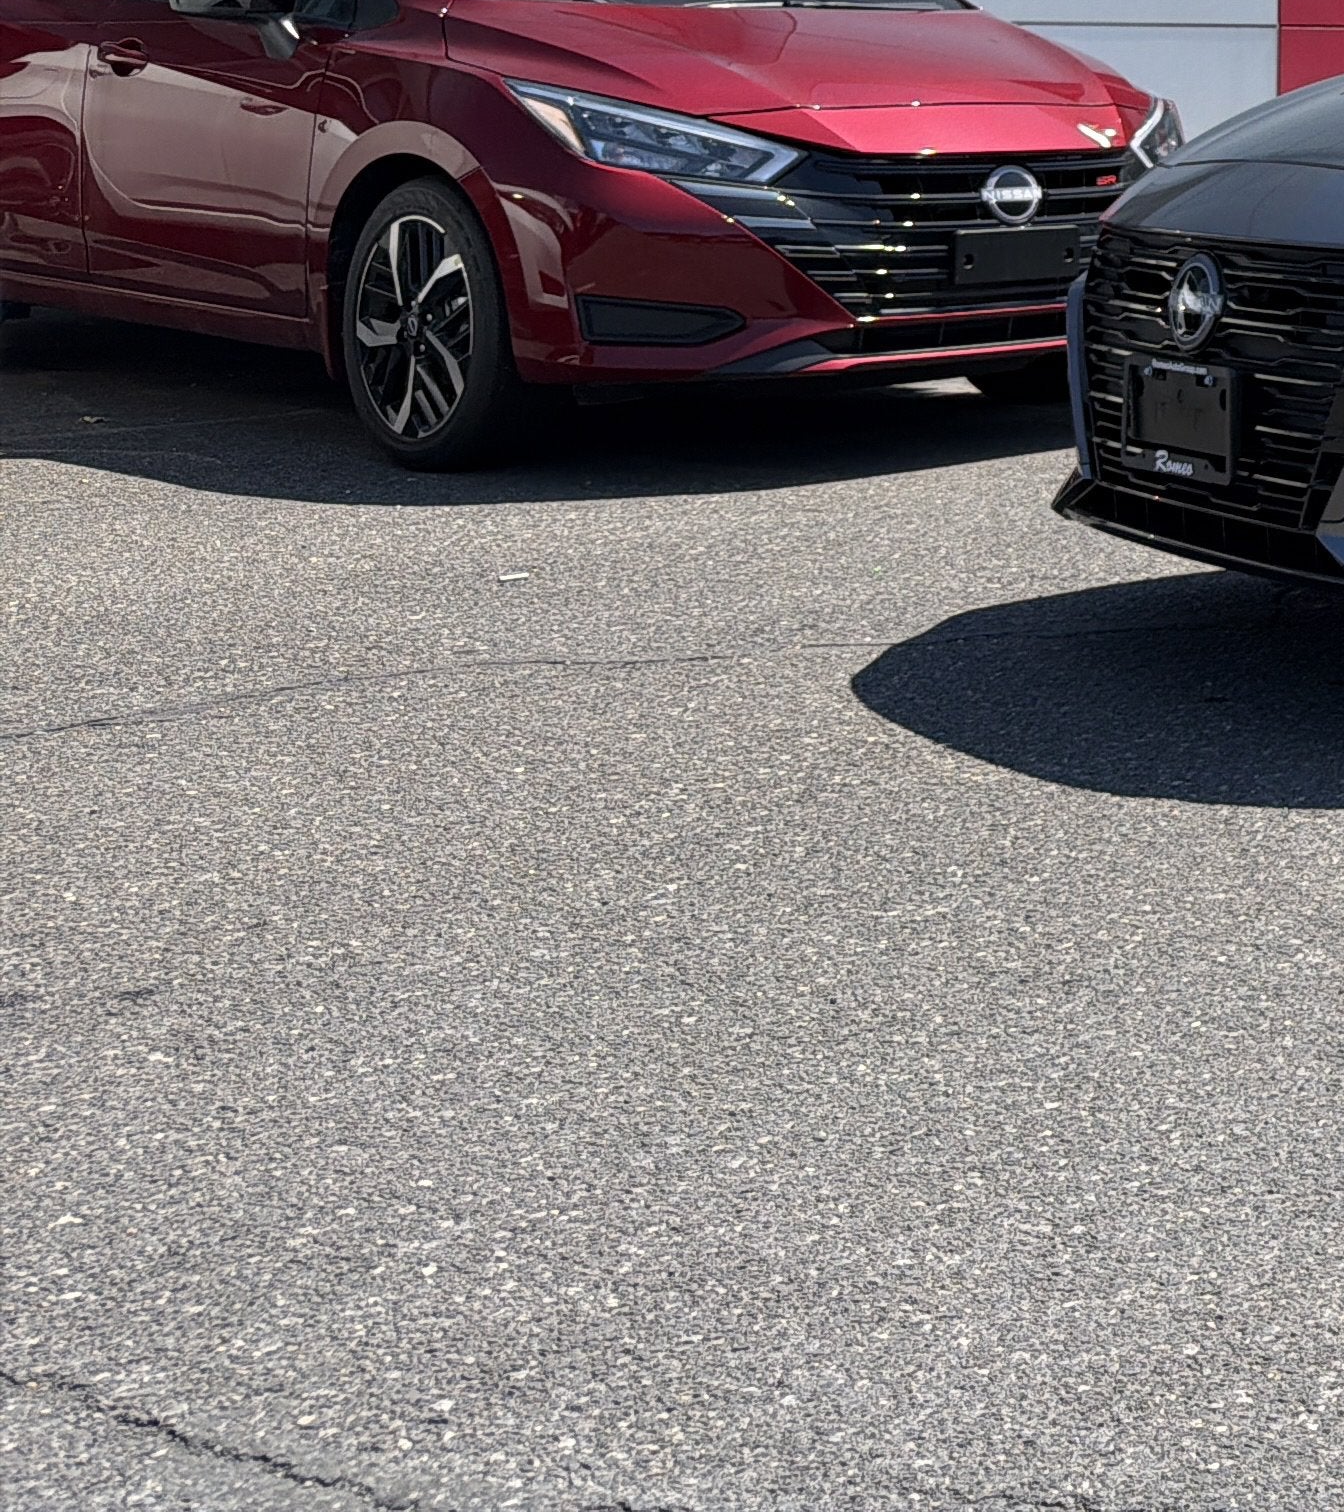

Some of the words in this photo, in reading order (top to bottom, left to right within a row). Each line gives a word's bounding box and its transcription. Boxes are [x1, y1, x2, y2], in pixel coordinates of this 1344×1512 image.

[1096, 174, 1117, 186] SR
[983, 187, 1042, 201] NISSAN
[1154, 449, 1194, 477] Romeo
